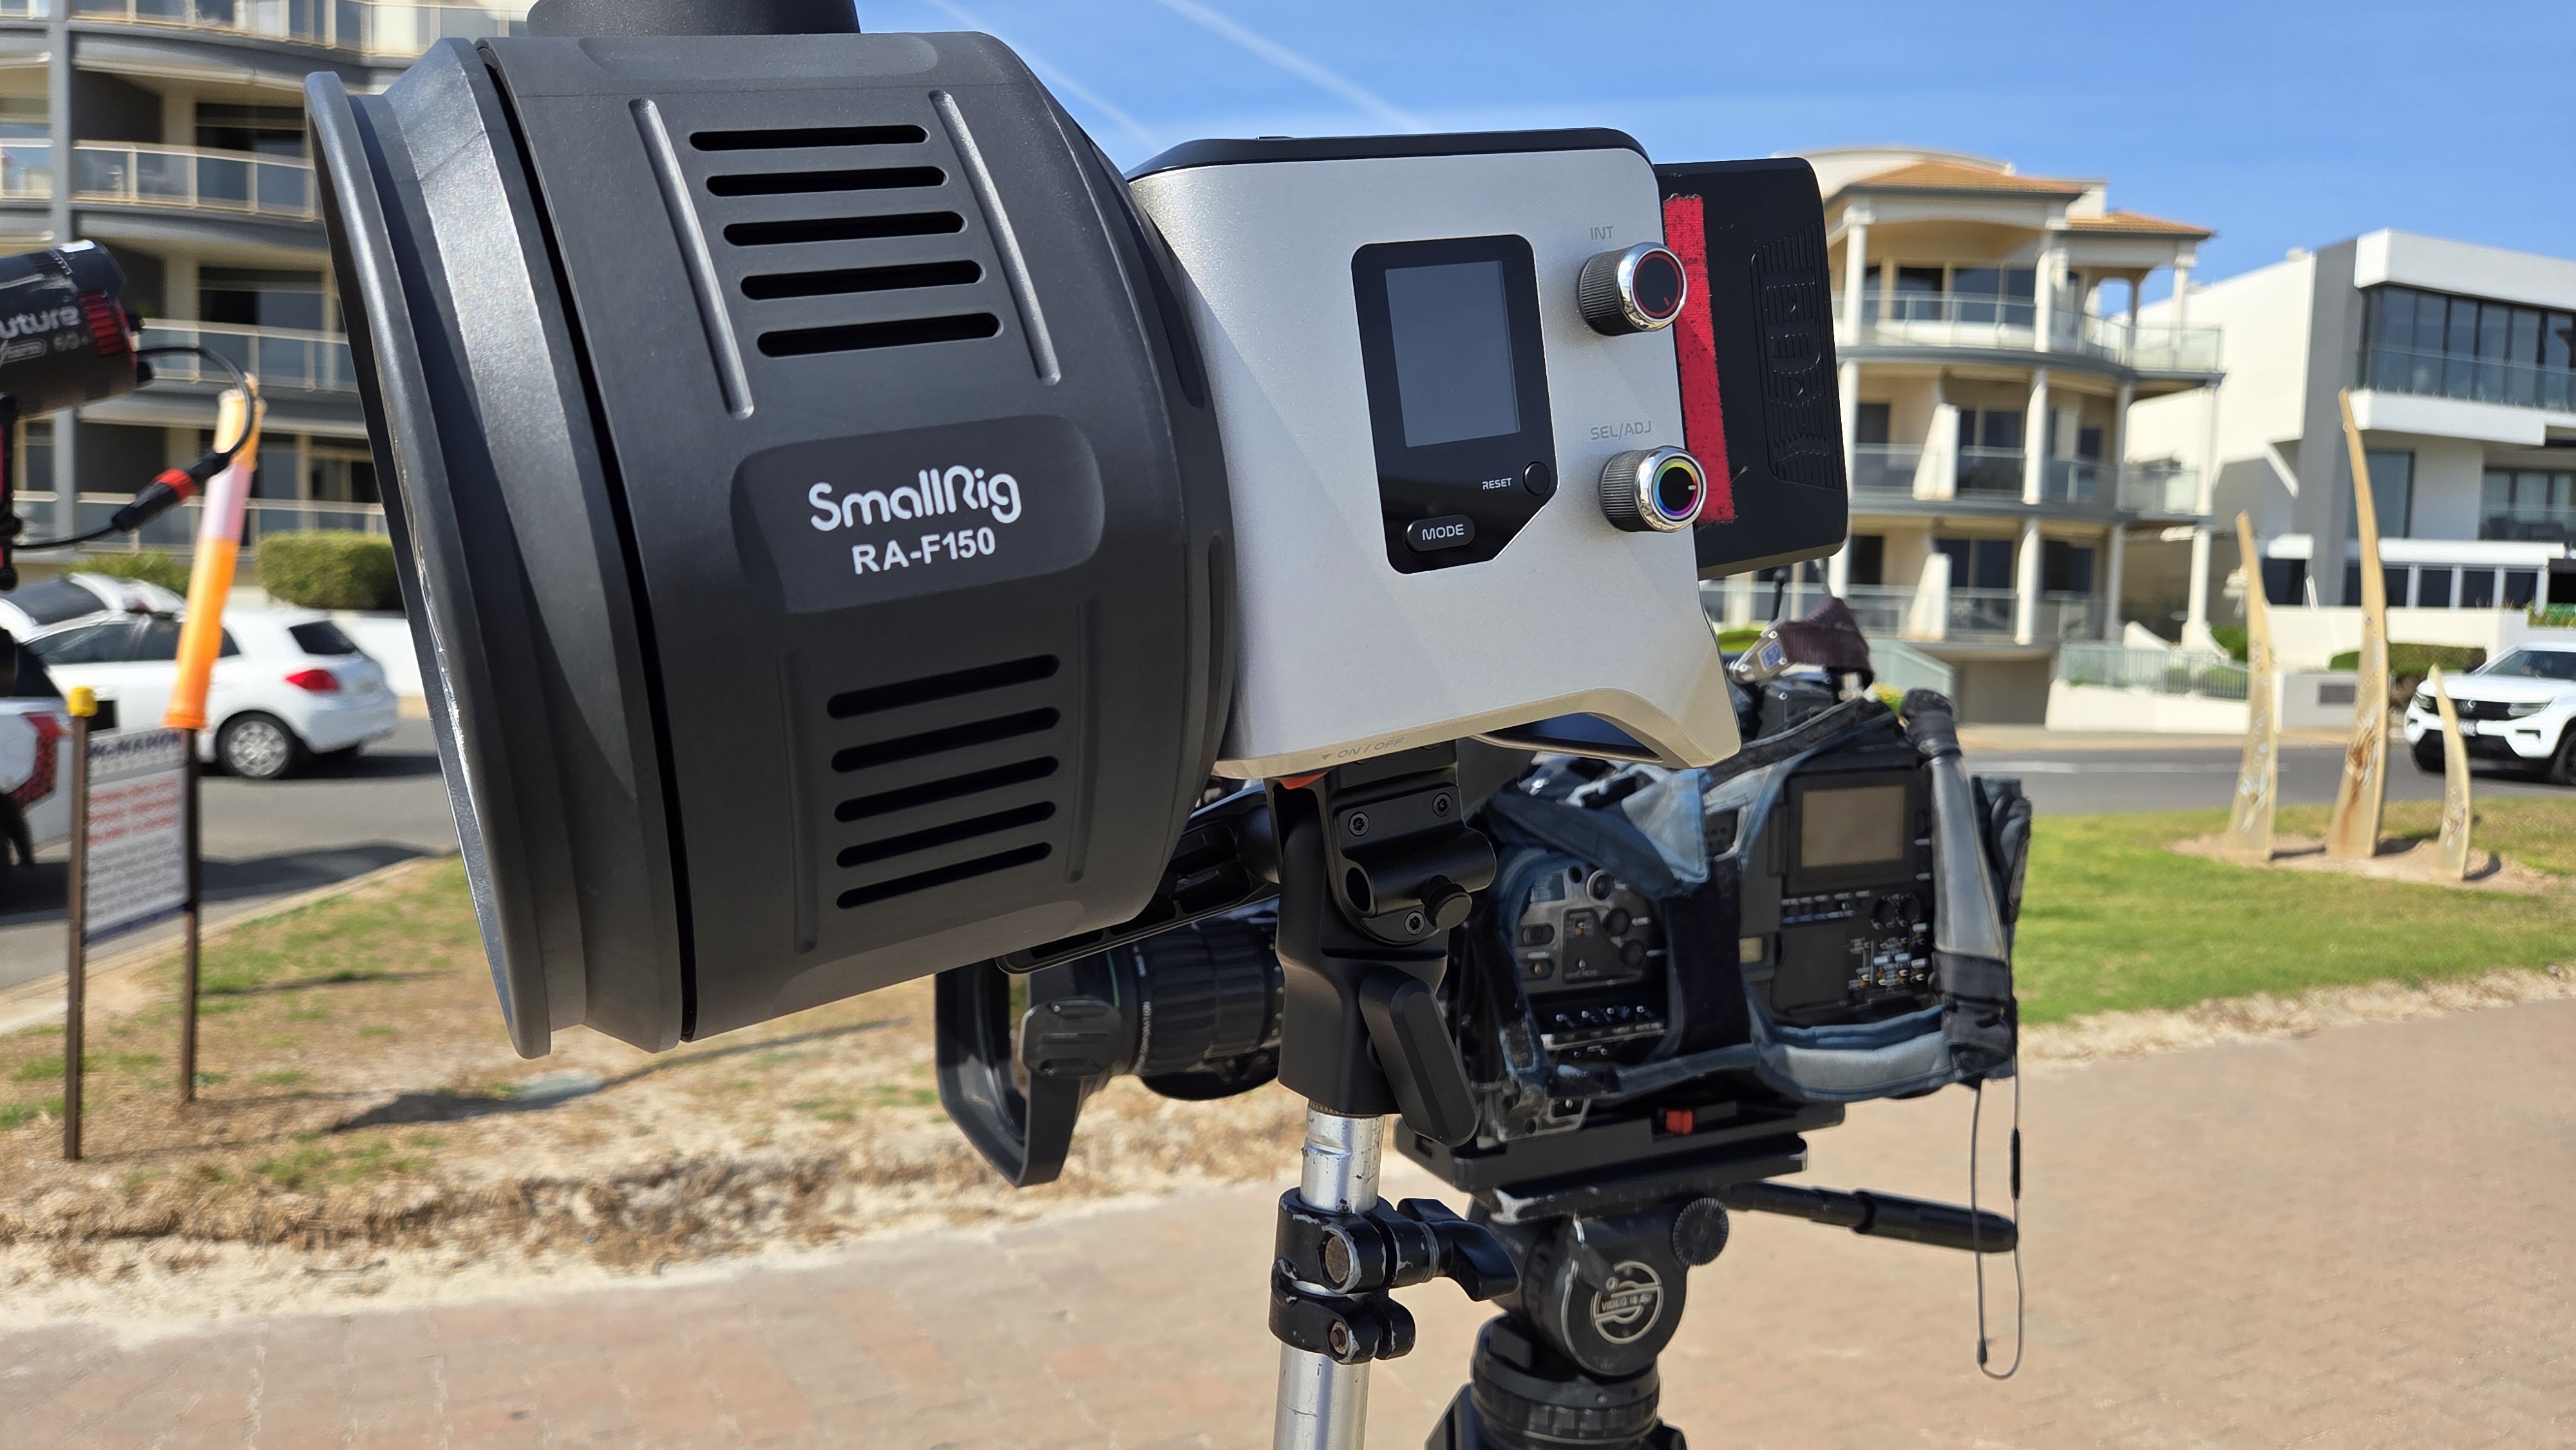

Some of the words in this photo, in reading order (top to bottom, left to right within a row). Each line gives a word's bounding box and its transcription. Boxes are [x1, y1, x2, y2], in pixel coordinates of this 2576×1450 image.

[1589, 225, 1614, 241] INT
[1589, 420, 1653, 441] SEL/ADJ
[1482, 476, 1512, 491] RESET
[808, 464, 1022, 532] SmallRig
[1421, 523, 1464, 541] MODE
[851, 526, 996, 575] RA-F150
[1337, 746, 1361, 758] ON
[1374, 737, 1405, 751] OFF
